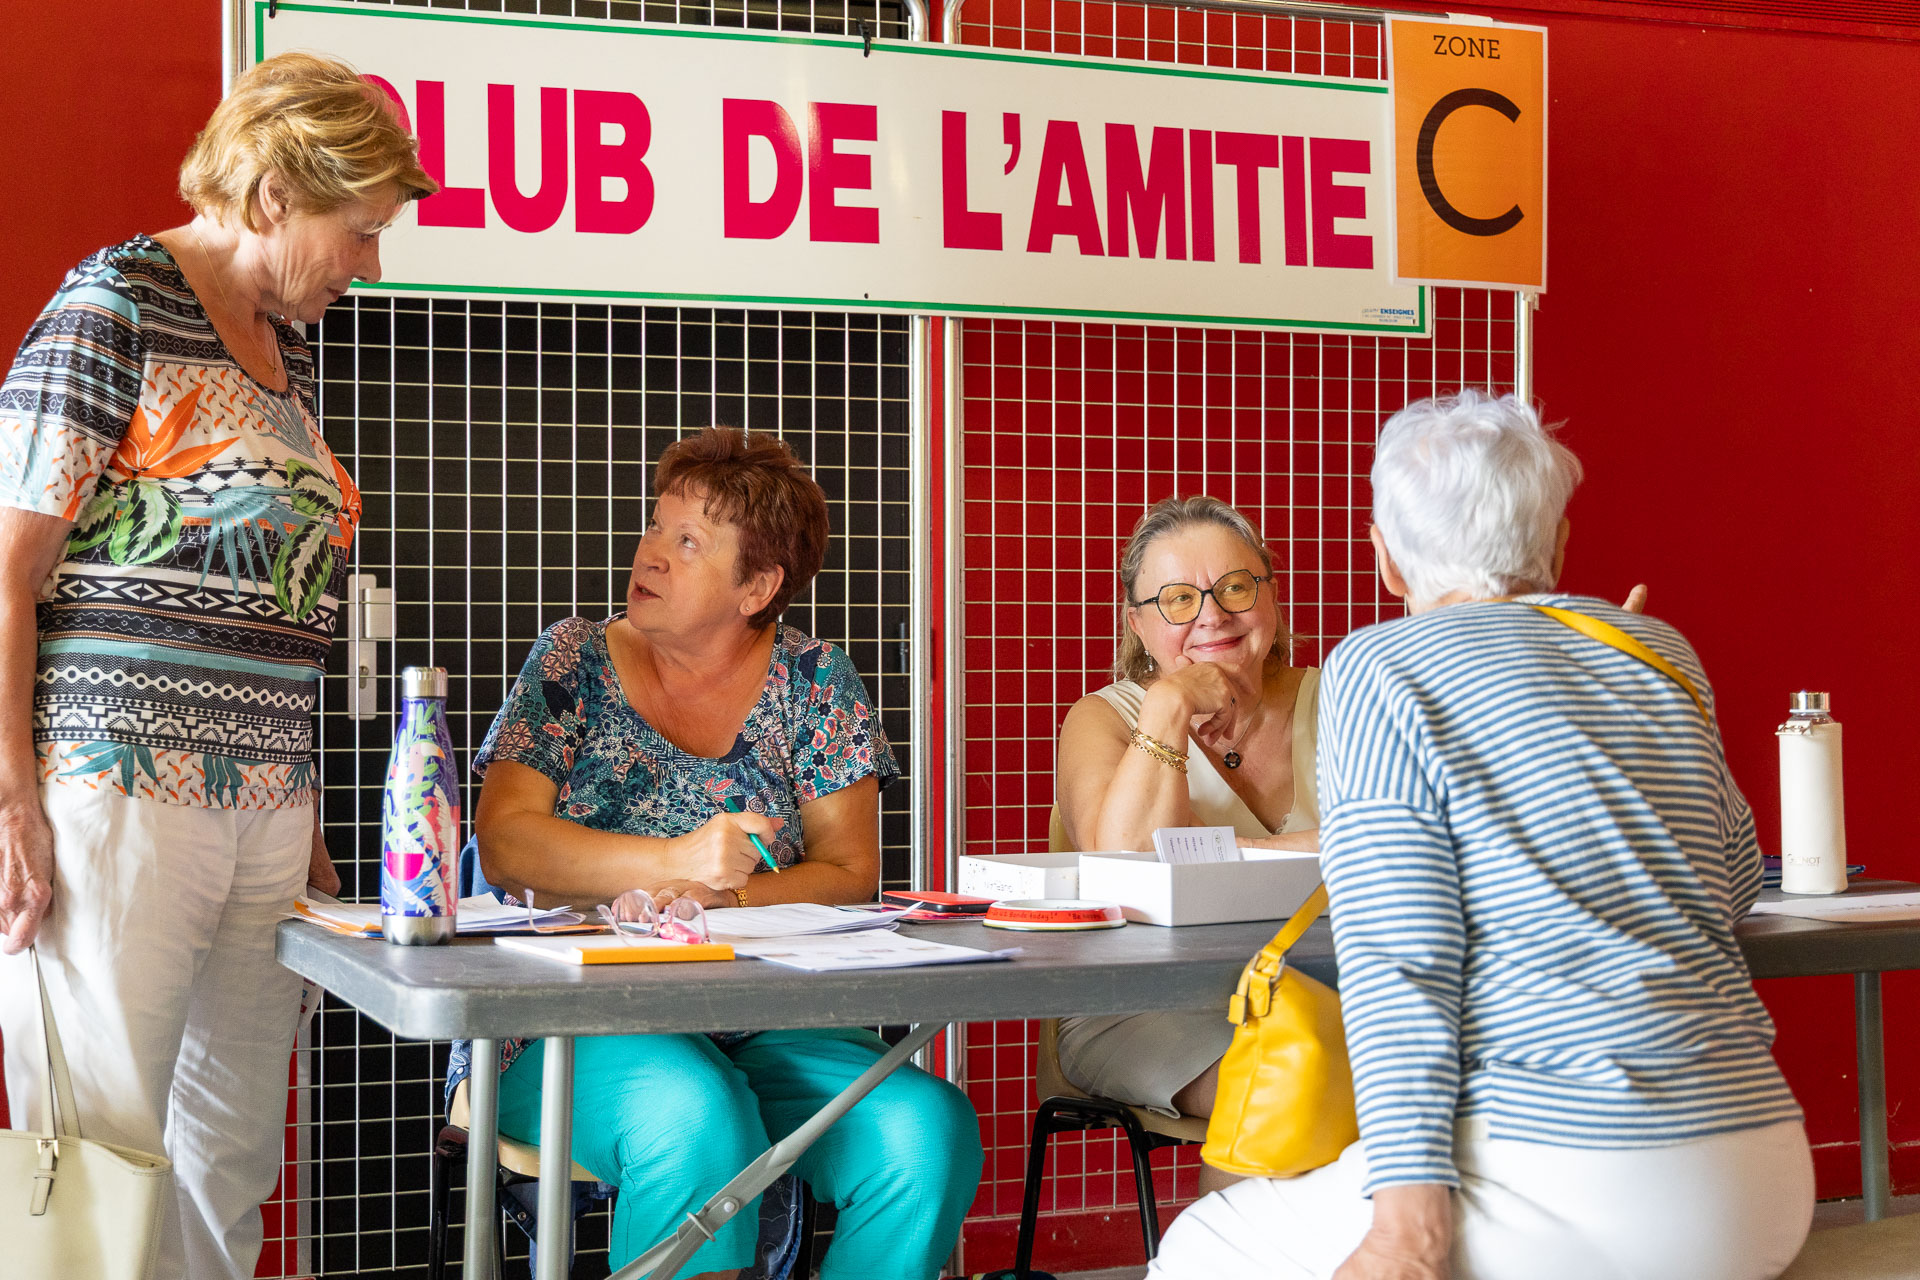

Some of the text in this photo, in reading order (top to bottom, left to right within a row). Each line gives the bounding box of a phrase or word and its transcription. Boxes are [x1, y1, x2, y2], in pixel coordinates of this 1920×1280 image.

[1433, 34, 1501, 60] ZONE
[722, 97, 880, 244] DE
[941, 109, 1374, 270] L'AMITIE
[1416, 87, 1525, 237] C
